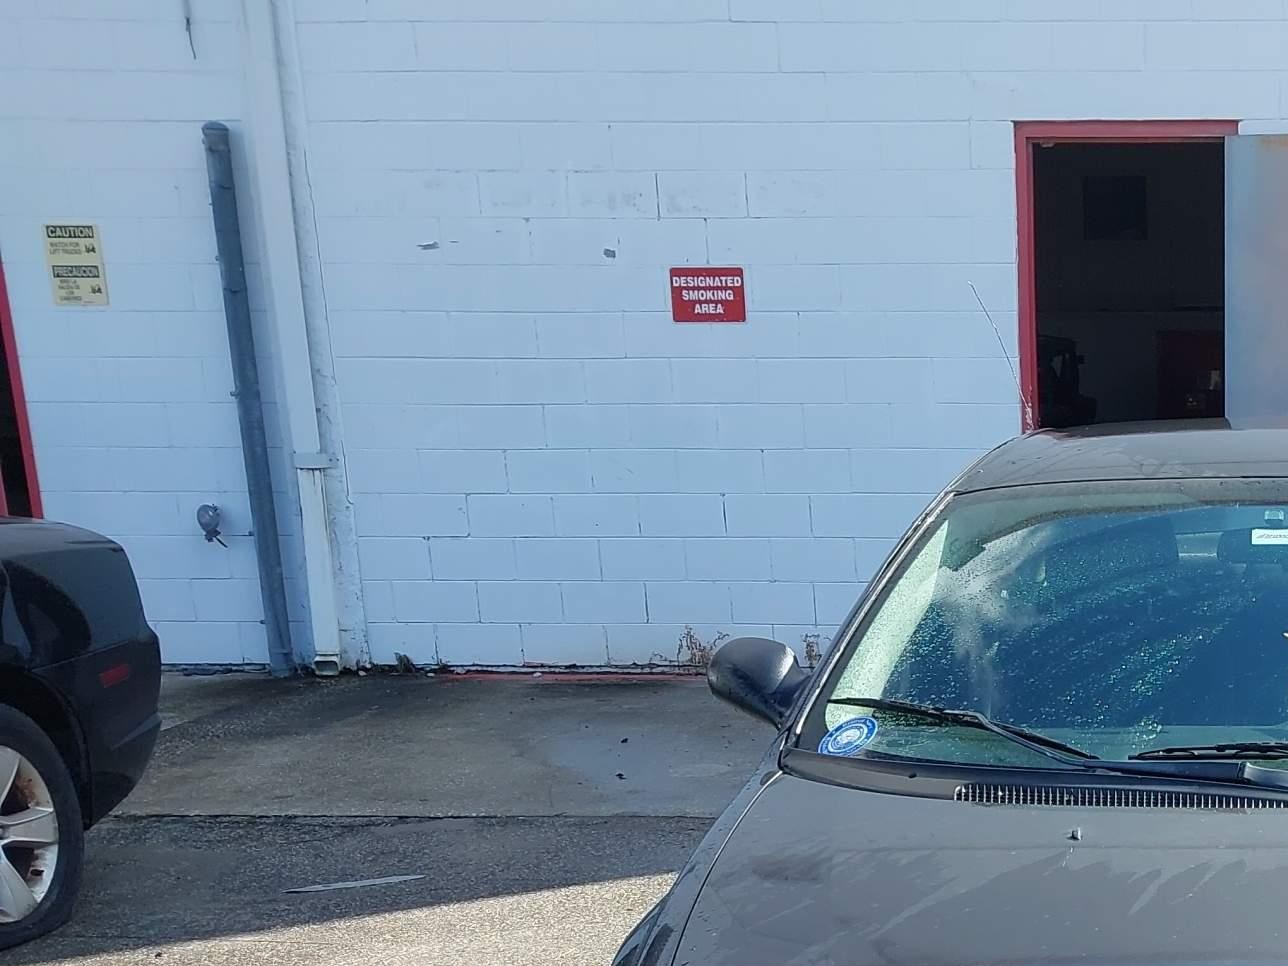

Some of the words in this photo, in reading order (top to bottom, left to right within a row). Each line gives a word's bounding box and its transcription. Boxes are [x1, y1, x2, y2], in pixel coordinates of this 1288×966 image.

[47, 227, 94, 238] CAUTION
[672, 276, 742, 287] DESIGNATED
[682, 290, 734, 301] SMOKING
[694, 304, 725, 314] AREA
